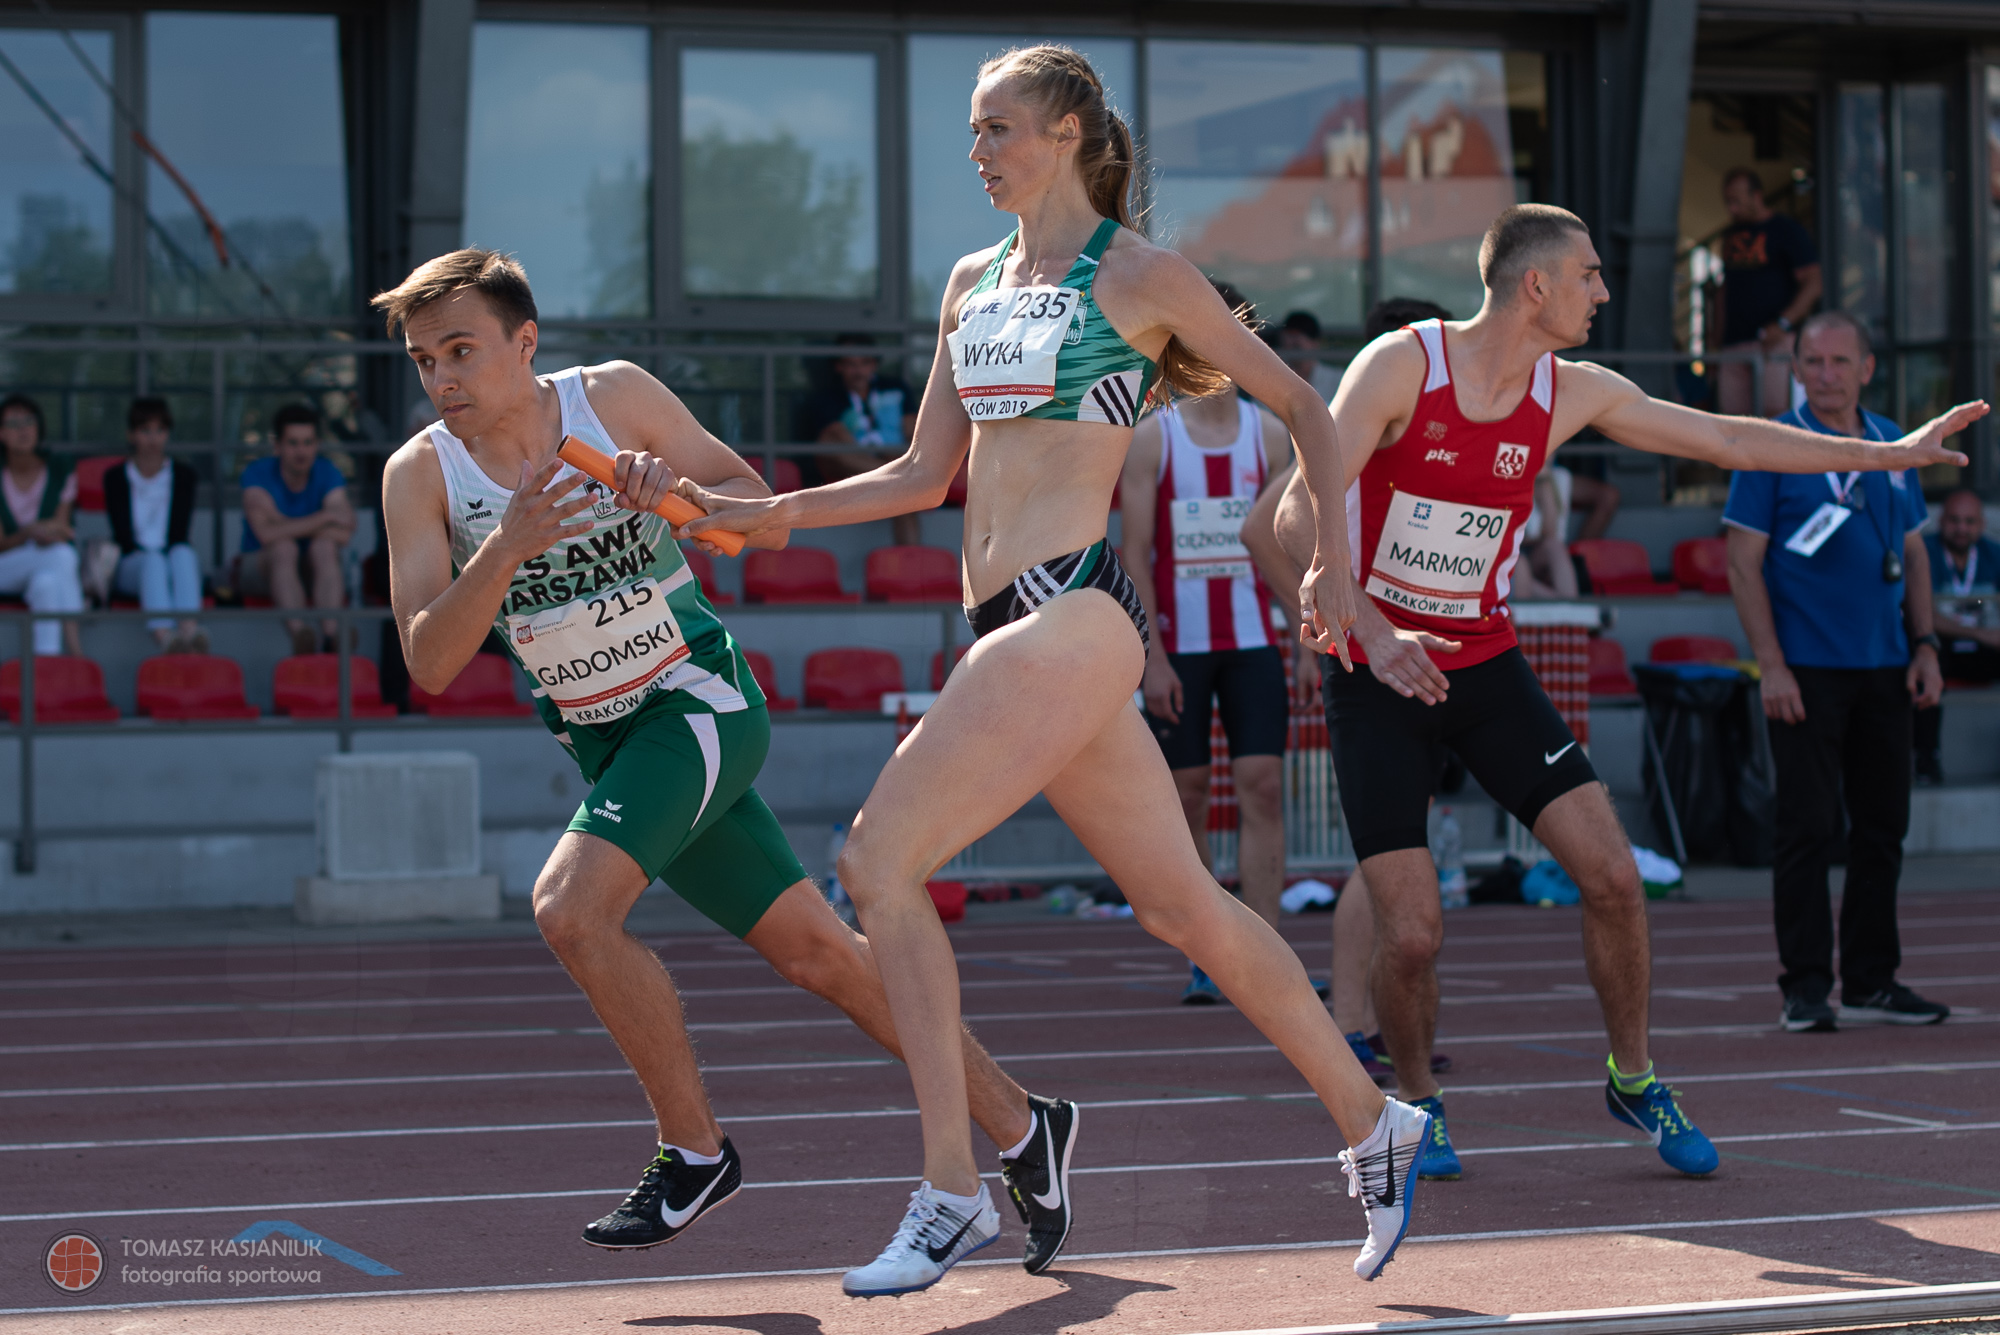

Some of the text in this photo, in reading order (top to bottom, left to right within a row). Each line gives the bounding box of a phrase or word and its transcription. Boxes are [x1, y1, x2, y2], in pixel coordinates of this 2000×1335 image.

[1011, 292, 1072, 320] 235
[964, 342, 1023, 367] WYKA
[998, 400, 1028, 414] 2019
[465, 509, 493, 522] erima
[1455, 511, 1504, 539] 290
[566, 512, 642, 569] AWF
[1389, 541, 1486, 577] MARMON
[587, 579, 653, 628] 215
[1383, 587, 1465, 615] KRAKÓW 2019
[538, 620, 675, 686] GADOMSKI
[575, 693, 640, 722] KRAKÓW
[592, 807, 622, 823] erima
